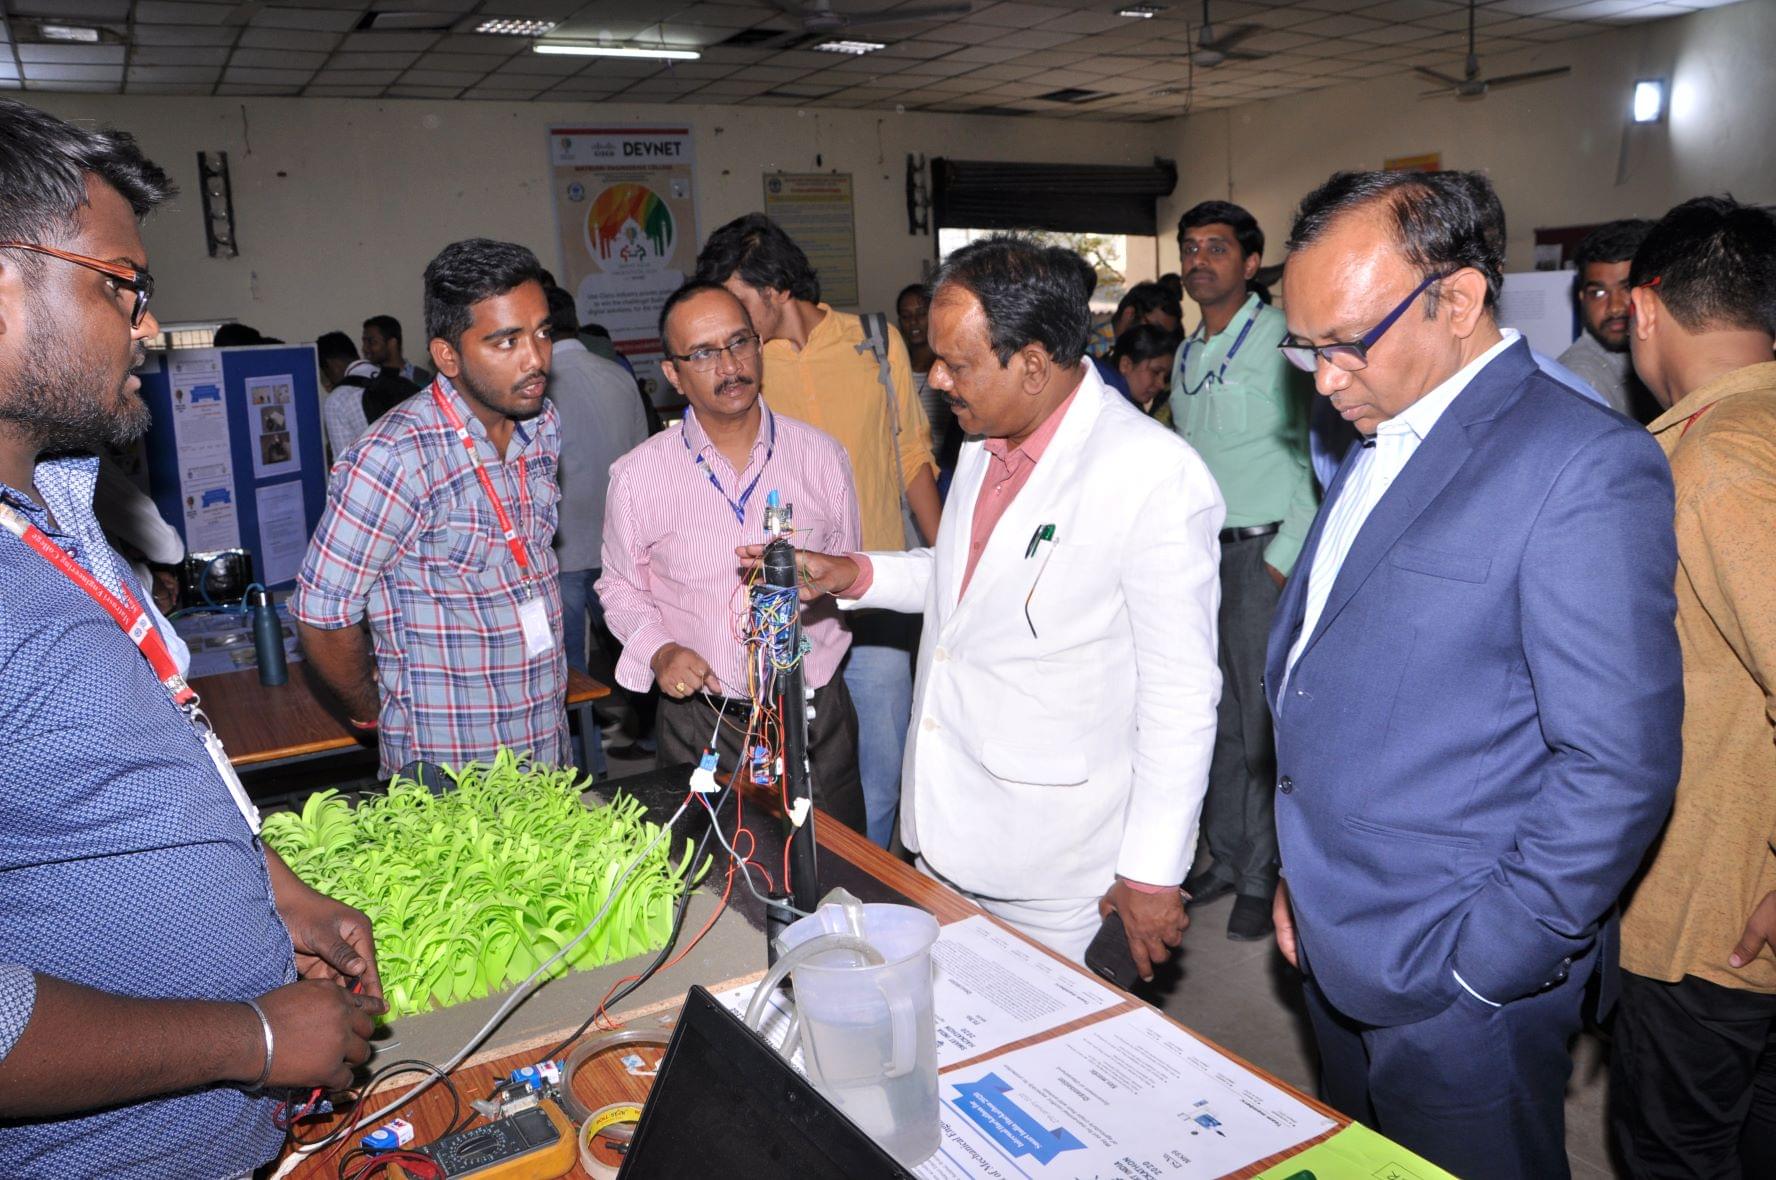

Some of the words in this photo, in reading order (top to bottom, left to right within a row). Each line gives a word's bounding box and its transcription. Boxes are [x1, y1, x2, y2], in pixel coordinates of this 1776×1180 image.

[623, 142, 682, 156] DEVNET
[31, 533, 59, 559] College
[60, 555, 104, 597] Engineering
[105, 593, 129, 626] Matrusri
[945, 1026, 975, 1049] HACKATHON
[949, 1039, 967, 1051] SMART
[975, 1106, 1005, 1130] Hackathon
[983, 1101, 1014, 1125] Hackathon
[952, 1137, 993, 1171] Mechanical
[1142, 1161, 1162, 1175] 2020
